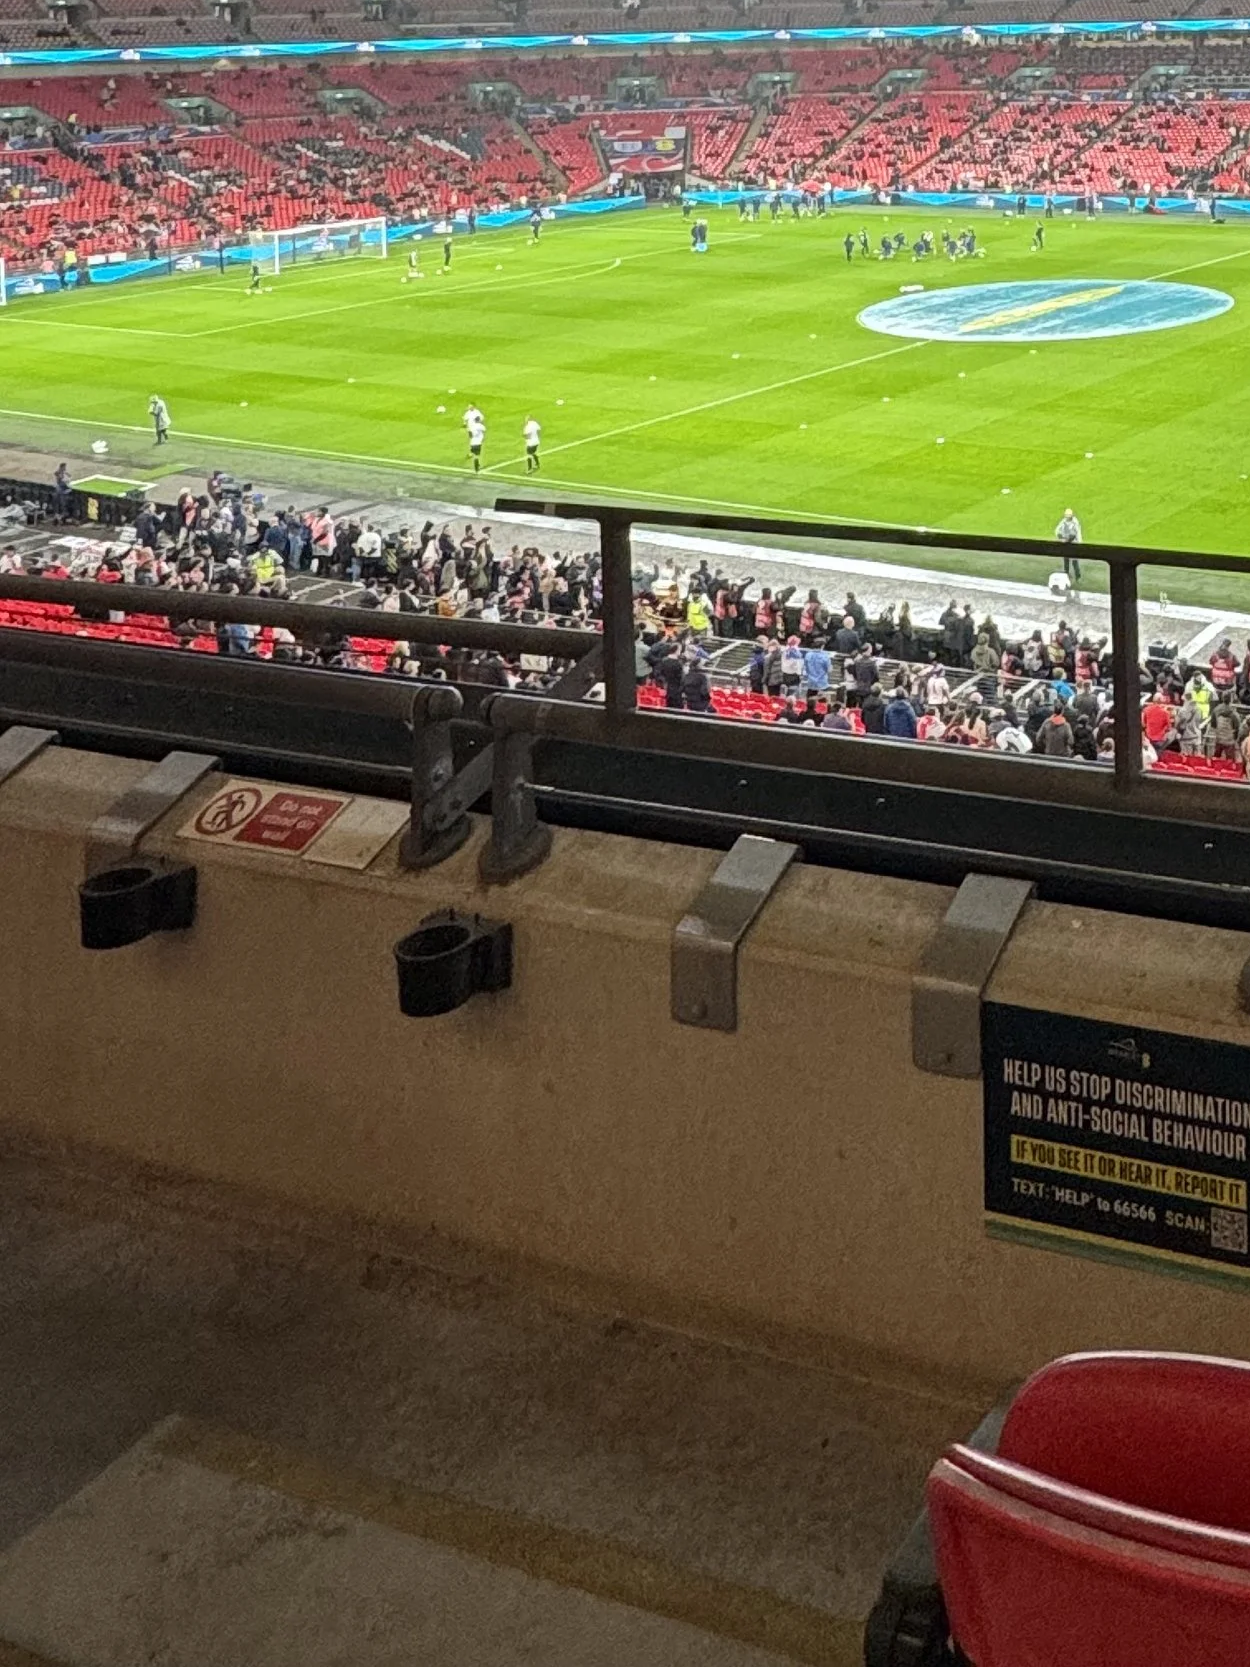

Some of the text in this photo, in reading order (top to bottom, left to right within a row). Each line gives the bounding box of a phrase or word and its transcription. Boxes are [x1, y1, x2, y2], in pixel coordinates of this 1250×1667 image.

[1003, 1058, 1041, 1089] HELP
[1044, 1067, 1066, 1093] US
[1070, 1070, 1111, 1101] STOP
[1011, 1091, 1246, 1162] AND ANTI-SOCIAL BEHAVIOUR
[1016, 1139, 1027, 1159] IF
[1031, 1142, 1054, 1165] YOU
[1058, 1148, 1080, 1172] SEE
[1084, 1154, 1095, 1174] IT
[1098, 1156, 1116, 1179] OR
[1120, 1161, 1151, 1186] HEAR
[1175, 1172, 1224, 1200] REPORT
[1229, 1183, 1241, 1204] IT
[1096, 1197, 1110, 1212] to
[1114, 1199, 1156, 1222] 66566
